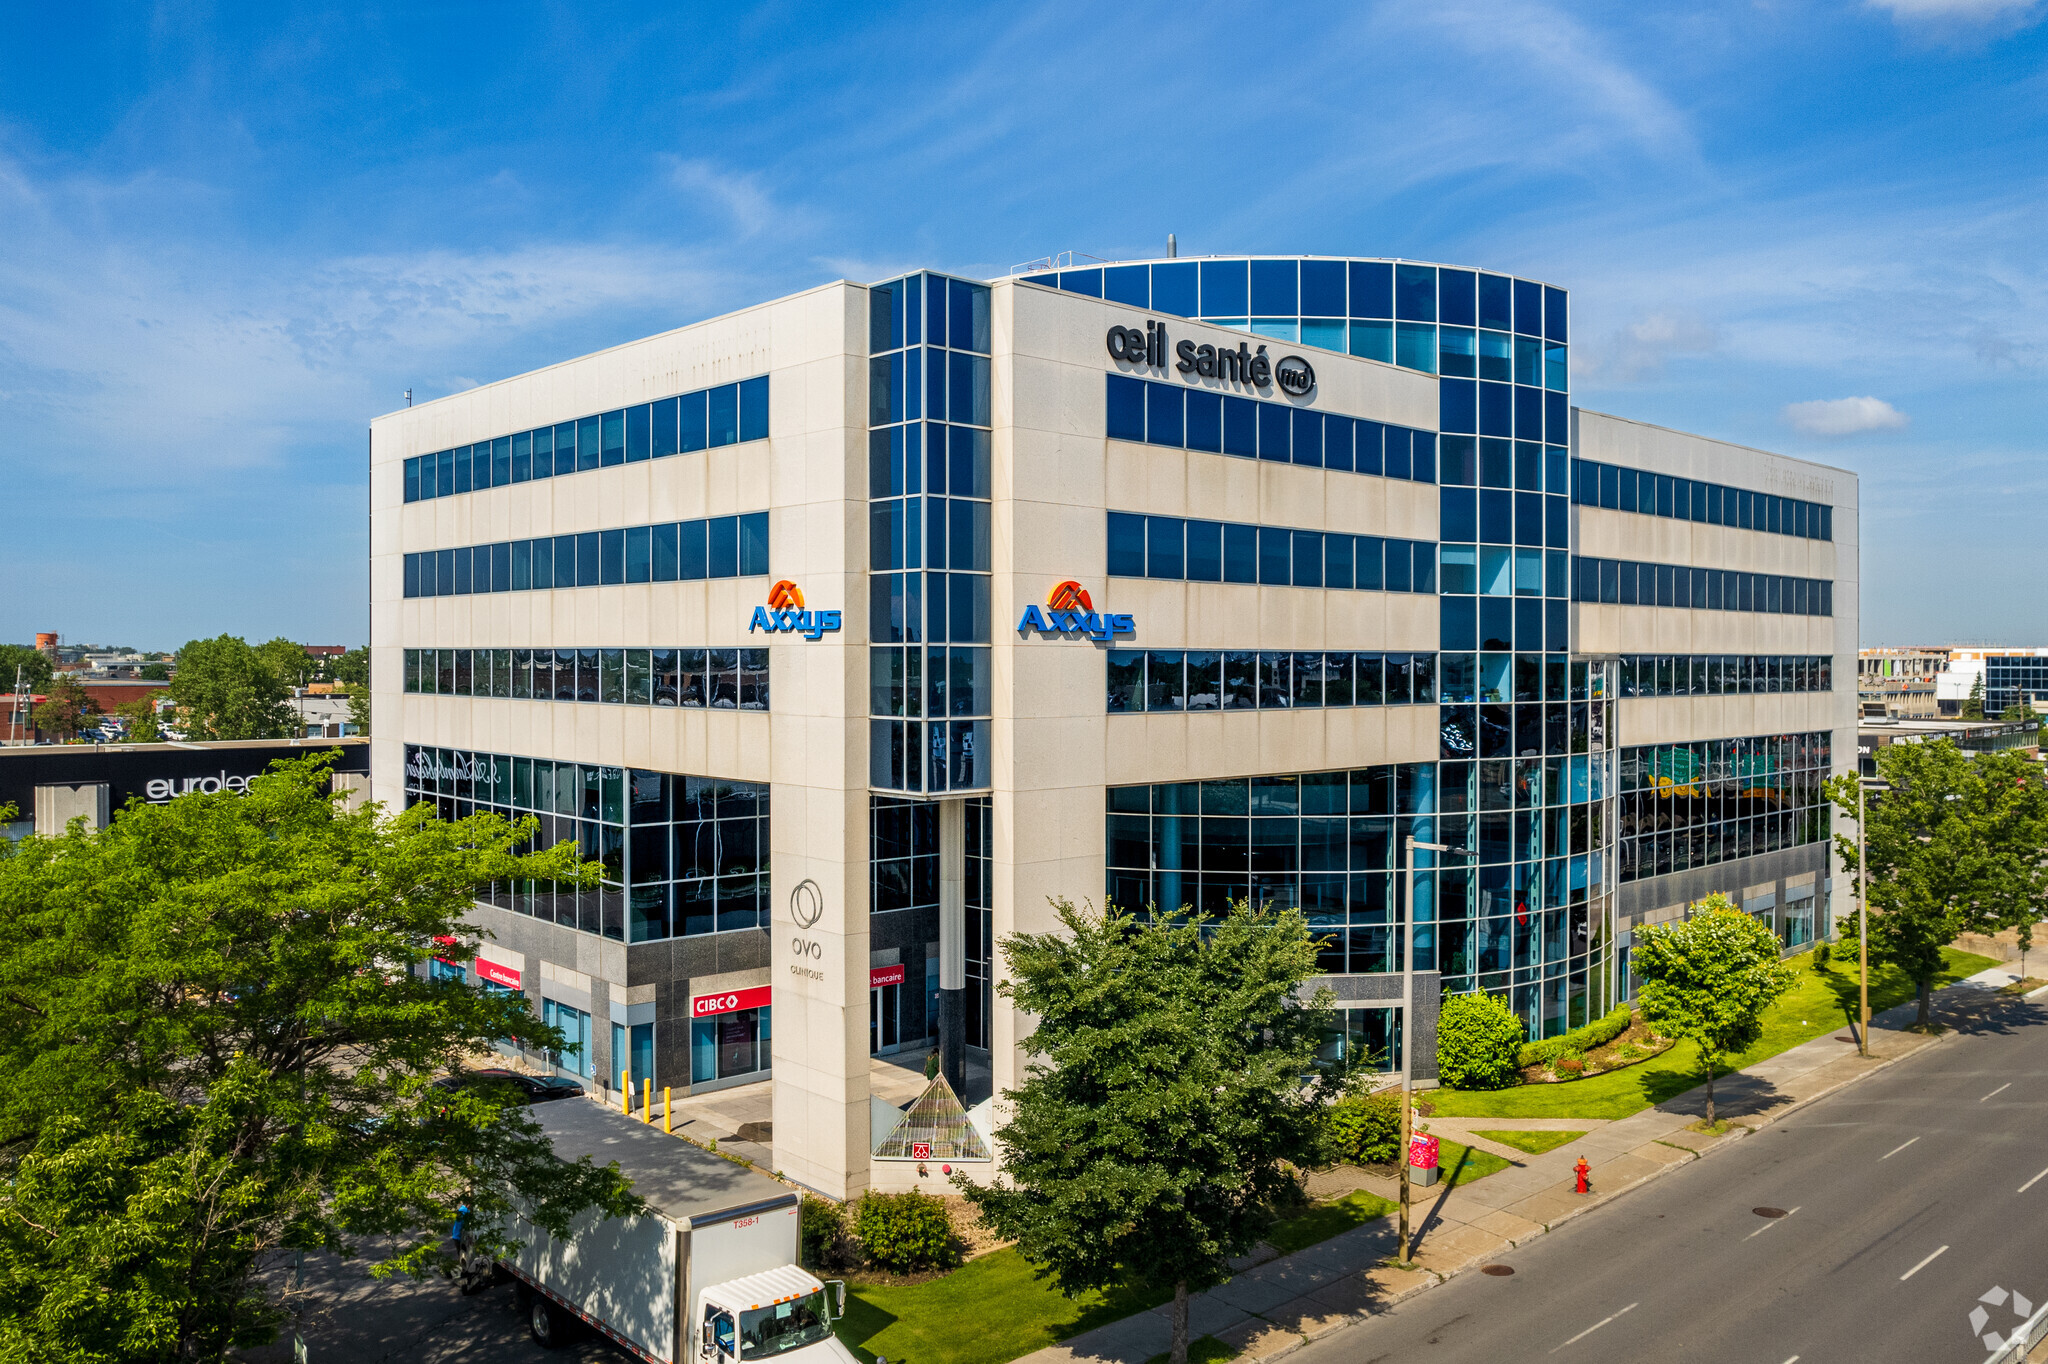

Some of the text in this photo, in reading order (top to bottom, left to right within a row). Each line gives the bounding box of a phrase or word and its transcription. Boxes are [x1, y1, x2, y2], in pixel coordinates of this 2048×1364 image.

[1107, 320, 1166, 368] œil
[1176, 339, 1272, 388] santé
[748, 605, 842, 639] Axxys
[1017, 604, 1135, 641] Axxys
[792, 937, 822, 960] OVO
[489, 968, 520, 987] Centre bancaire
[790, 965, 824, 982] CLINIQUE
[872, 973, 902, 985] bancaire
[696, 997, 725, 1013] CIBC
[733, 1216, 759, 1230] T358-1
